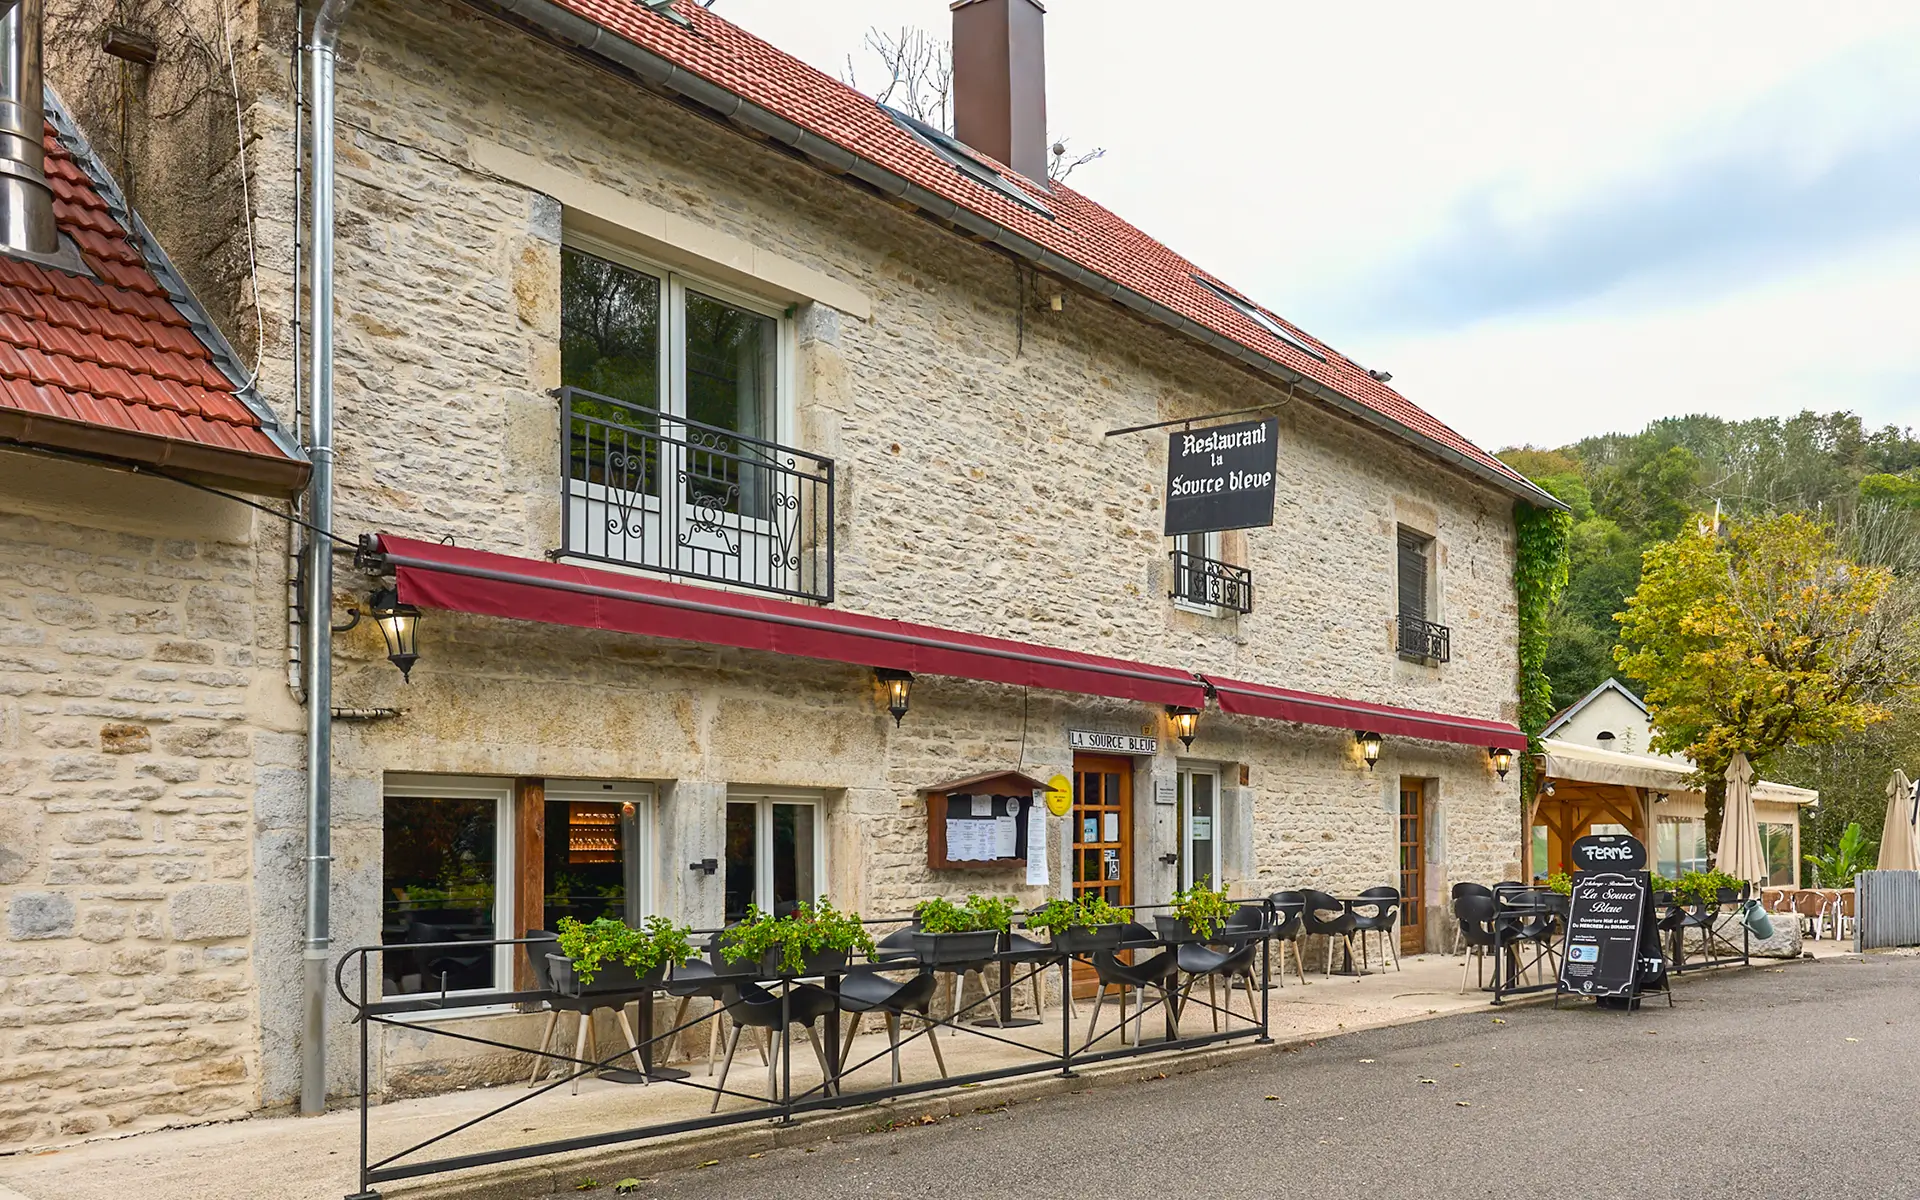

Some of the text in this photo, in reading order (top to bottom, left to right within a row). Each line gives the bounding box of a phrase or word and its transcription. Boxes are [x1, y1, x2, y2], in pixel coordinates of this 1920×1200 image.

[1182, 422, 1266, 457] Restaurant
[1210, 453, 1223, 467] la
[1171, 470, 1272, 497] Source bleue
[1071, 732, 1156, 752] LA SOURCE BLEUE
[1580, 888, 1636, 900] La Source
